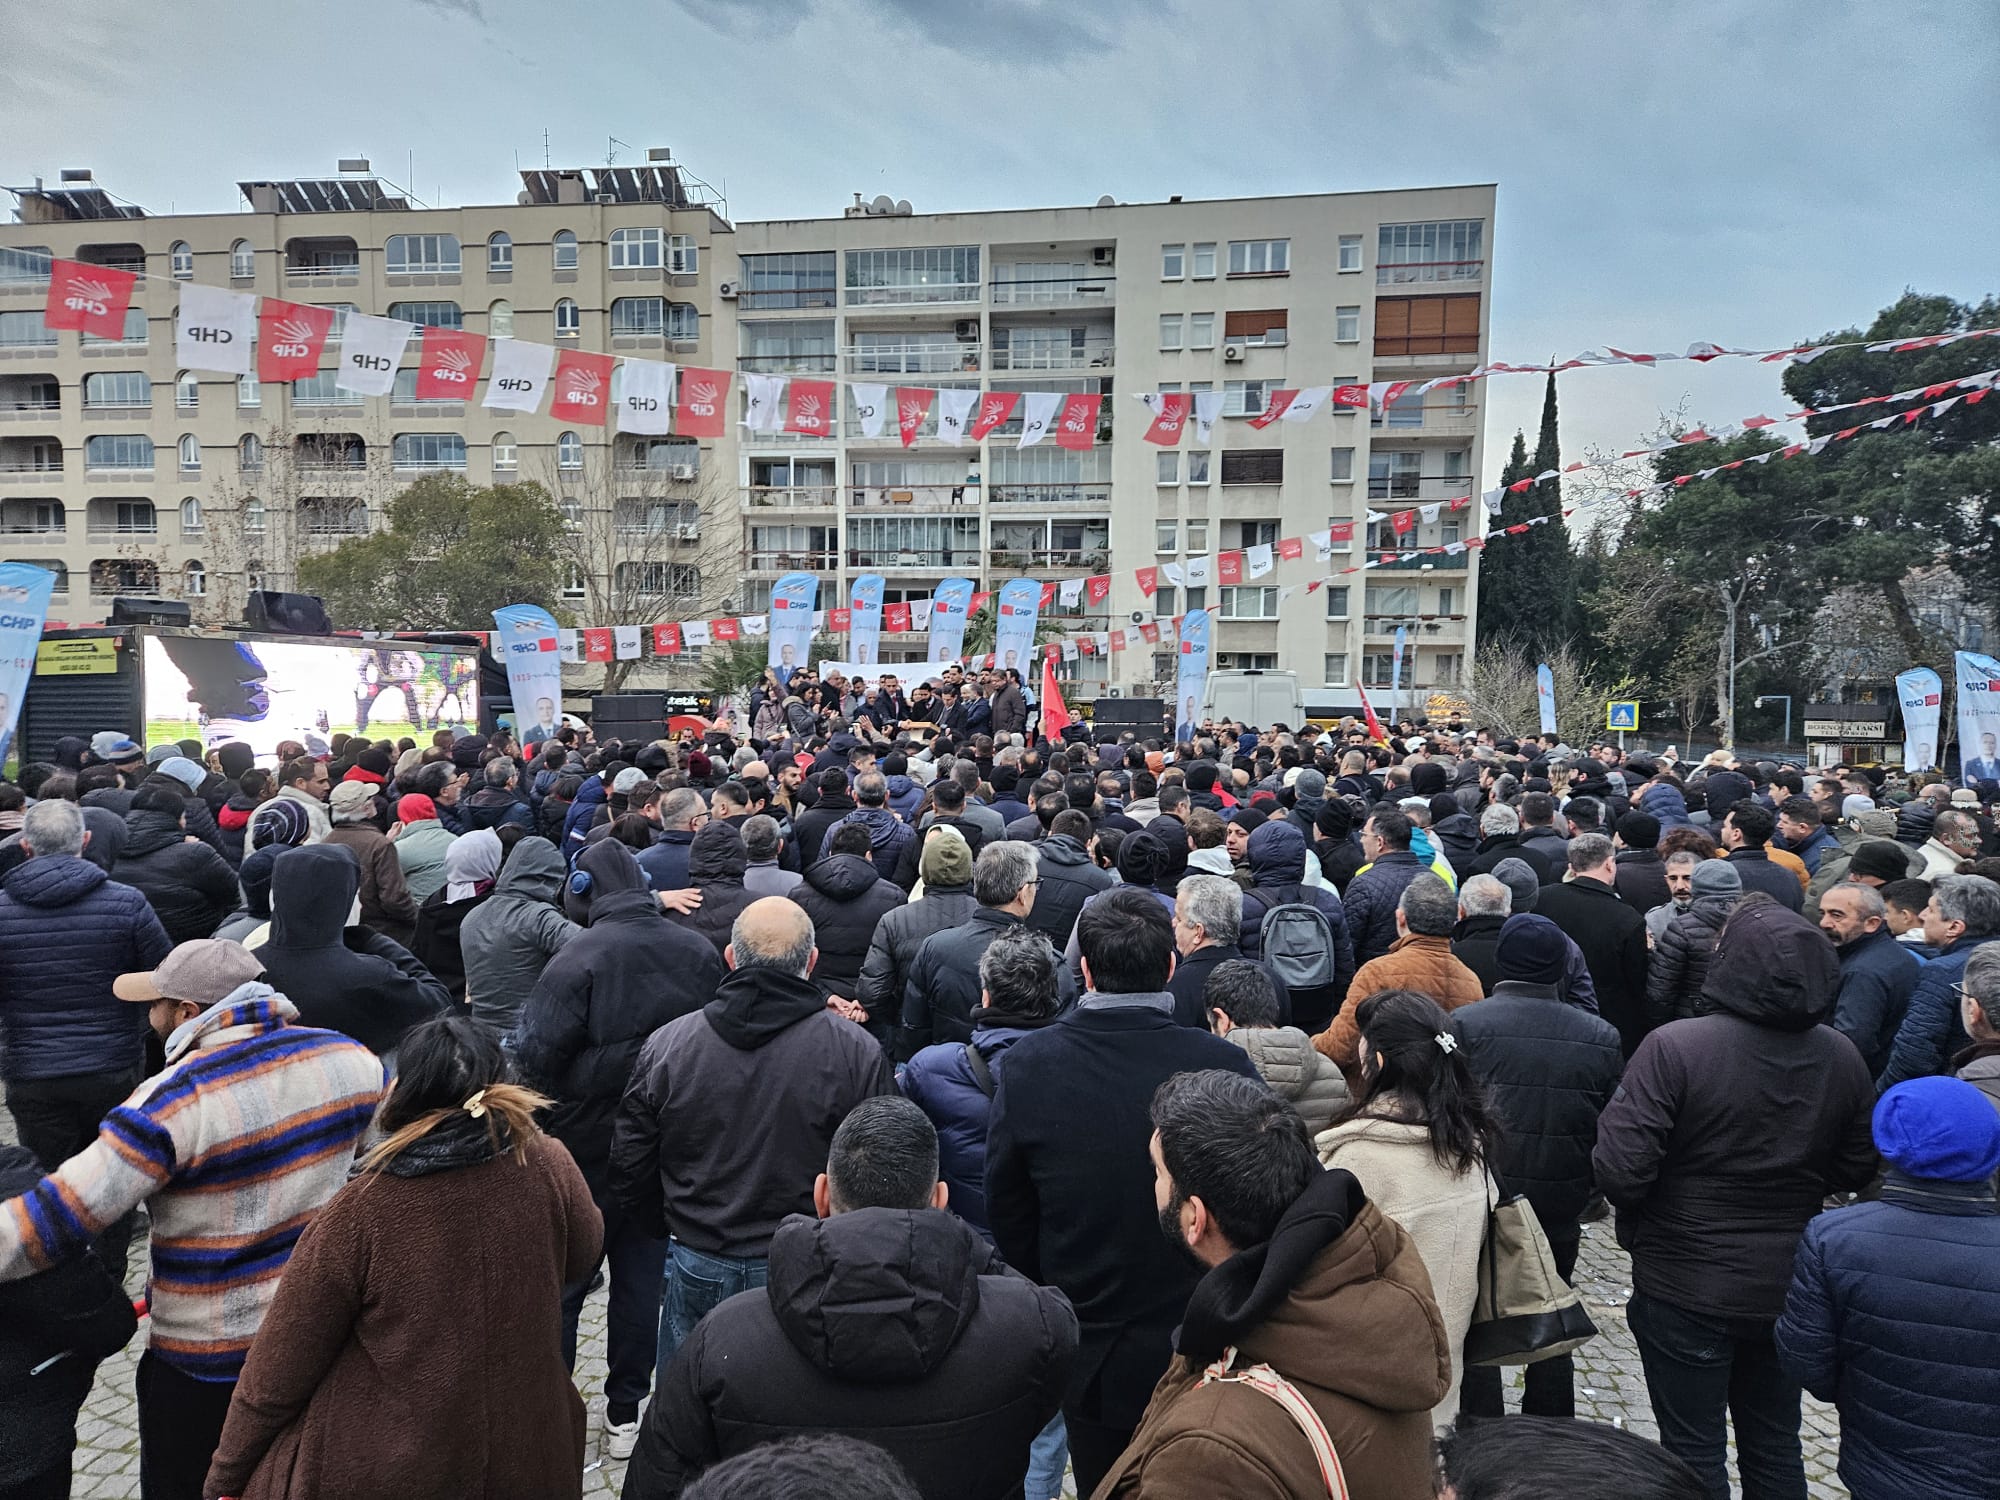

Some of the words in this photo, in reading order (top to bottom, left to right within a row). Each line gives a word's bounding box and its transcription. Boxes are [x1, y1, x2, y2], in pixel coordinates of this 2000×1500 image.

[789, 601, 808, 609] CHP
[948, 604, 964, 613] CHP
[1014, 607, 1033, 616] CHP
[0, 615, 36, 629] CHP
